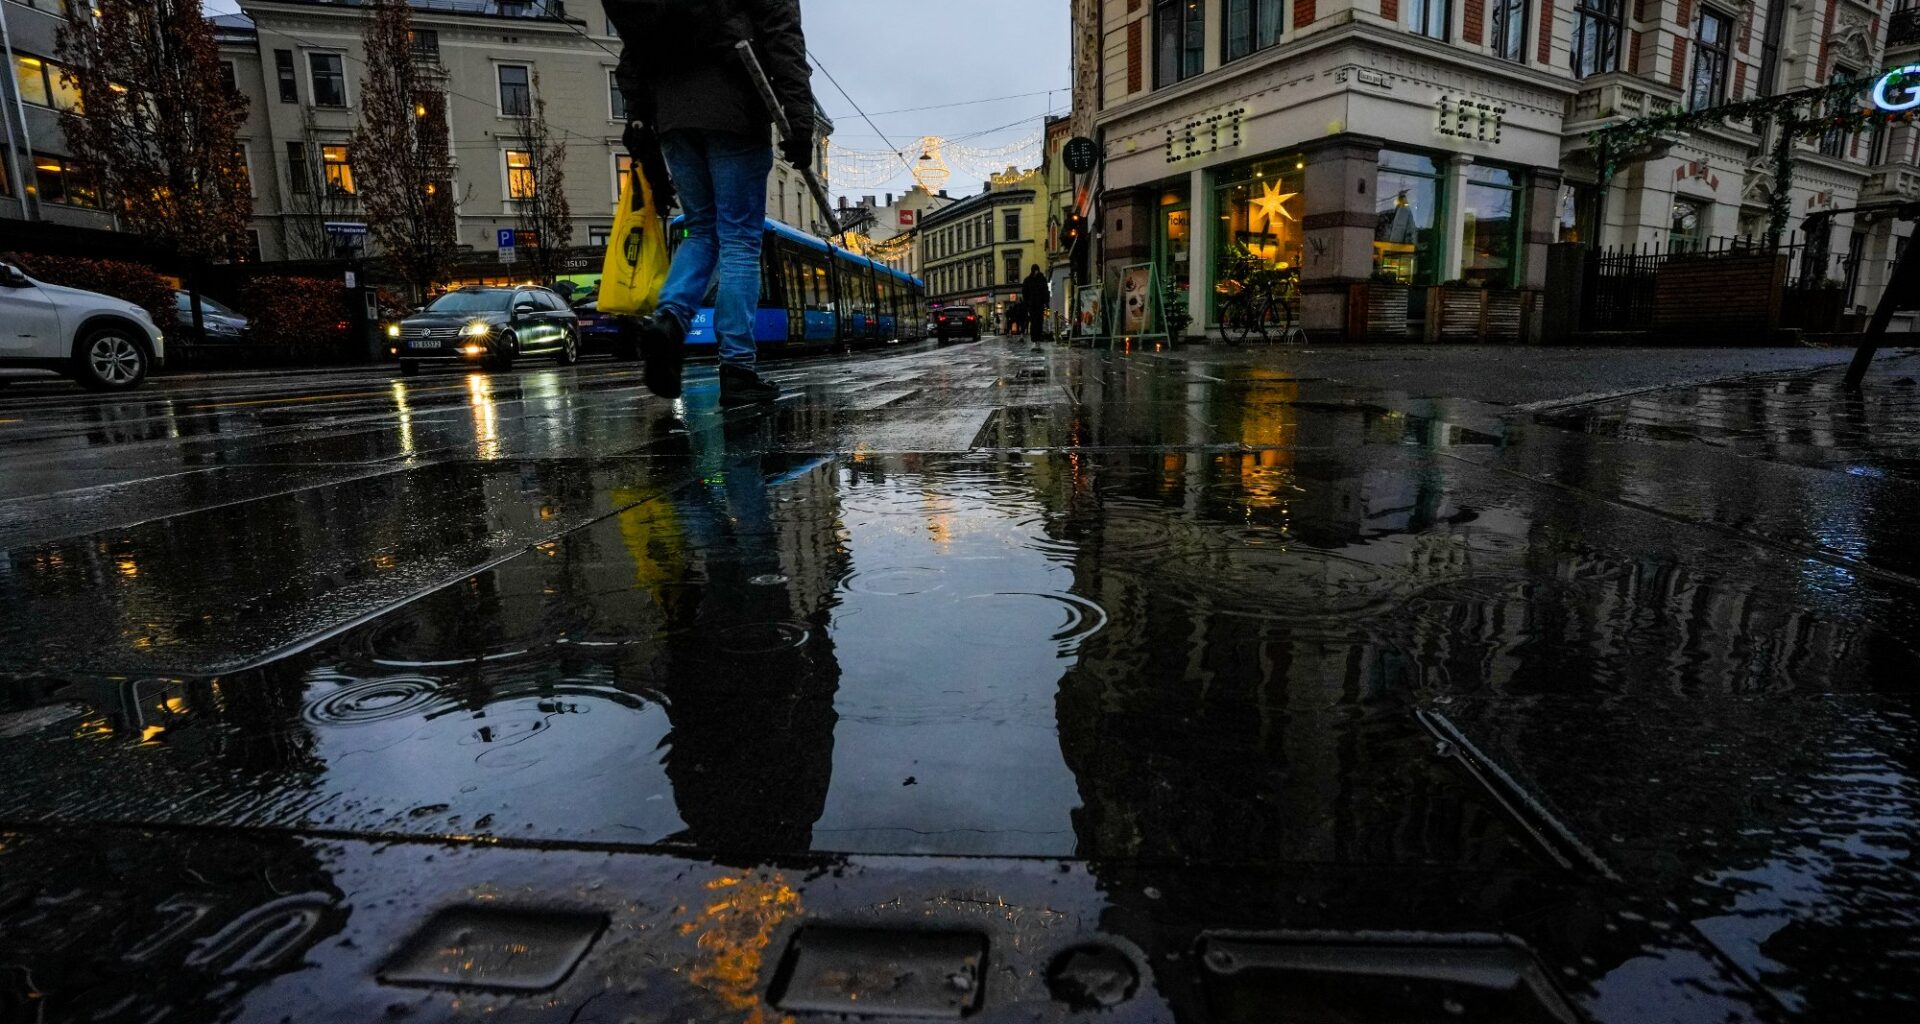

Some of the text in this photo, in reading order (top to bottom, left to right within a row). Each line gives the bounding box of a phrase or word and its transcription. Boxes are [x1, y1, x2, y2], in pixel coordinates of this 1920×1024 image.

[1440, 95, 1506, 144] LETT
[1166, 108, 1244, 163] LETT
[501, 231, 510, 245] P
[691, 314, 706, 323] 26
